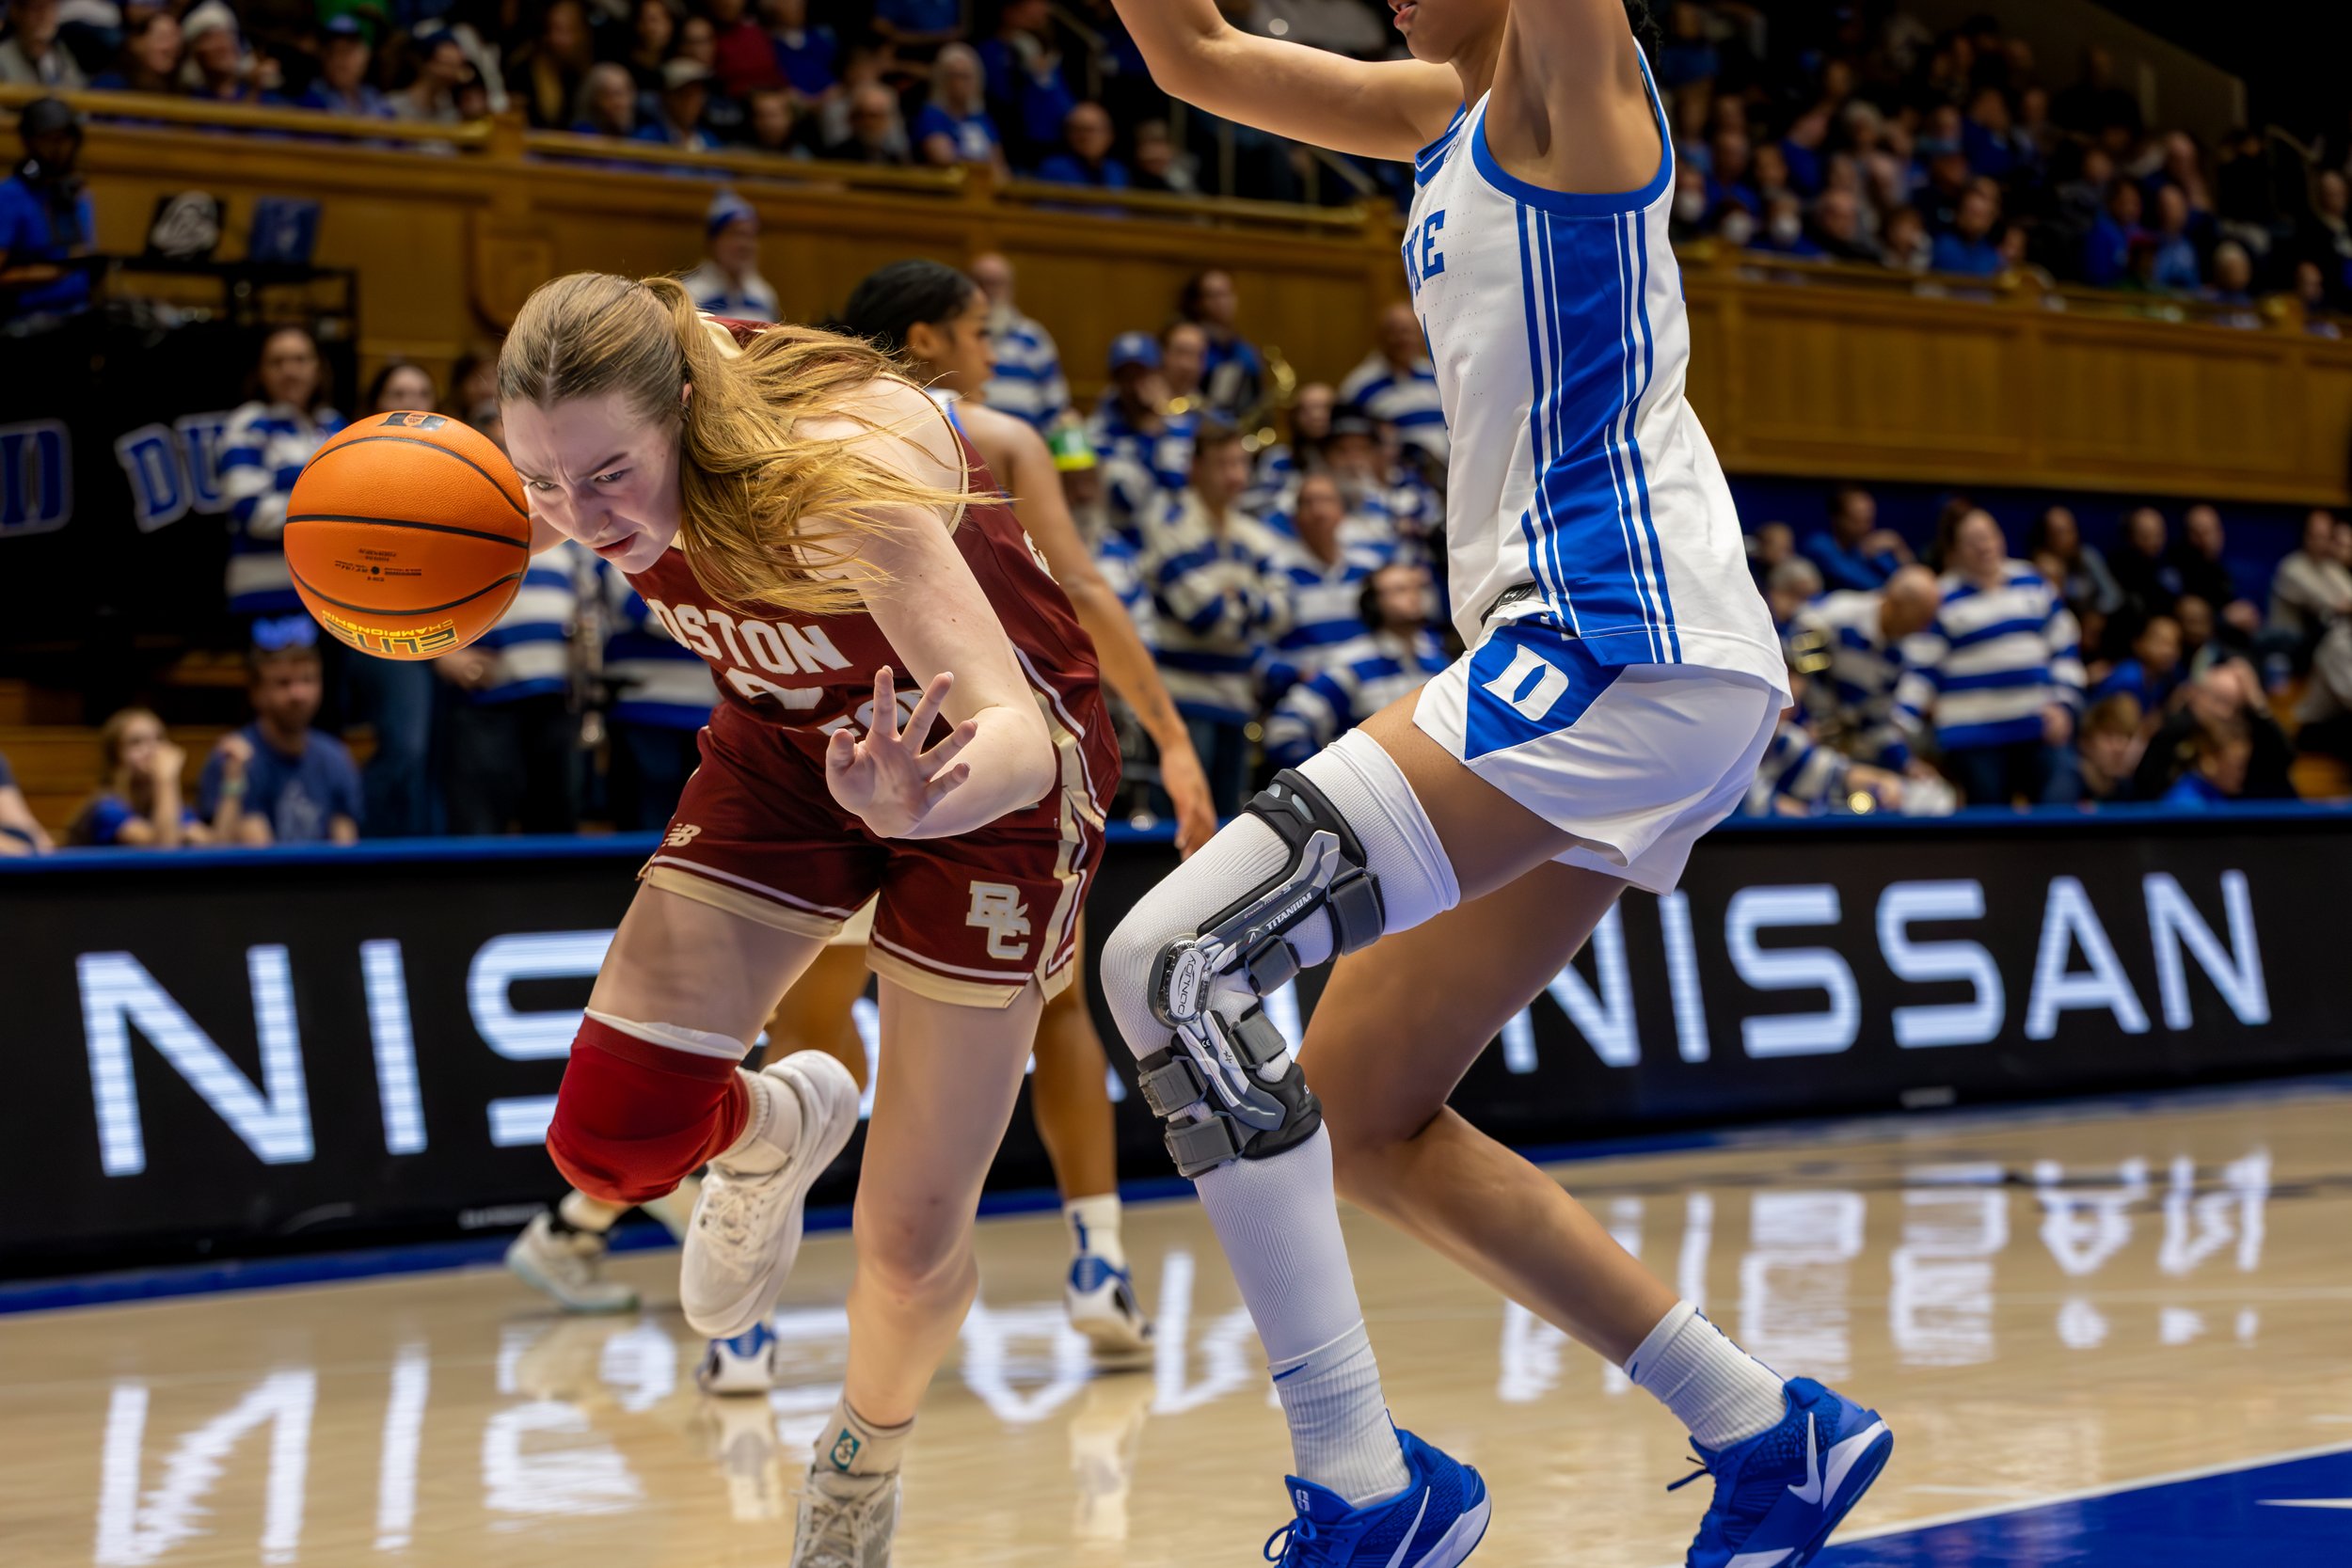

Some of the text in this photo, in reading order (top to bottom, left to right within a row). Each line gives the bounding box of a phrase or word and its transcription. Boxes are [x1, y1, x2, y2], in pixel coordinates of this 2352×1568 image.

[321, 610, 454, 636] CHAMPIONSHIP
[322, 616, 458, 655] ELITE
[646, 598, 853, 675] OSTON
[1265, 892, 1312, 930] TITANIUM
[1177, 953, 1197, 1016] DONJOY
